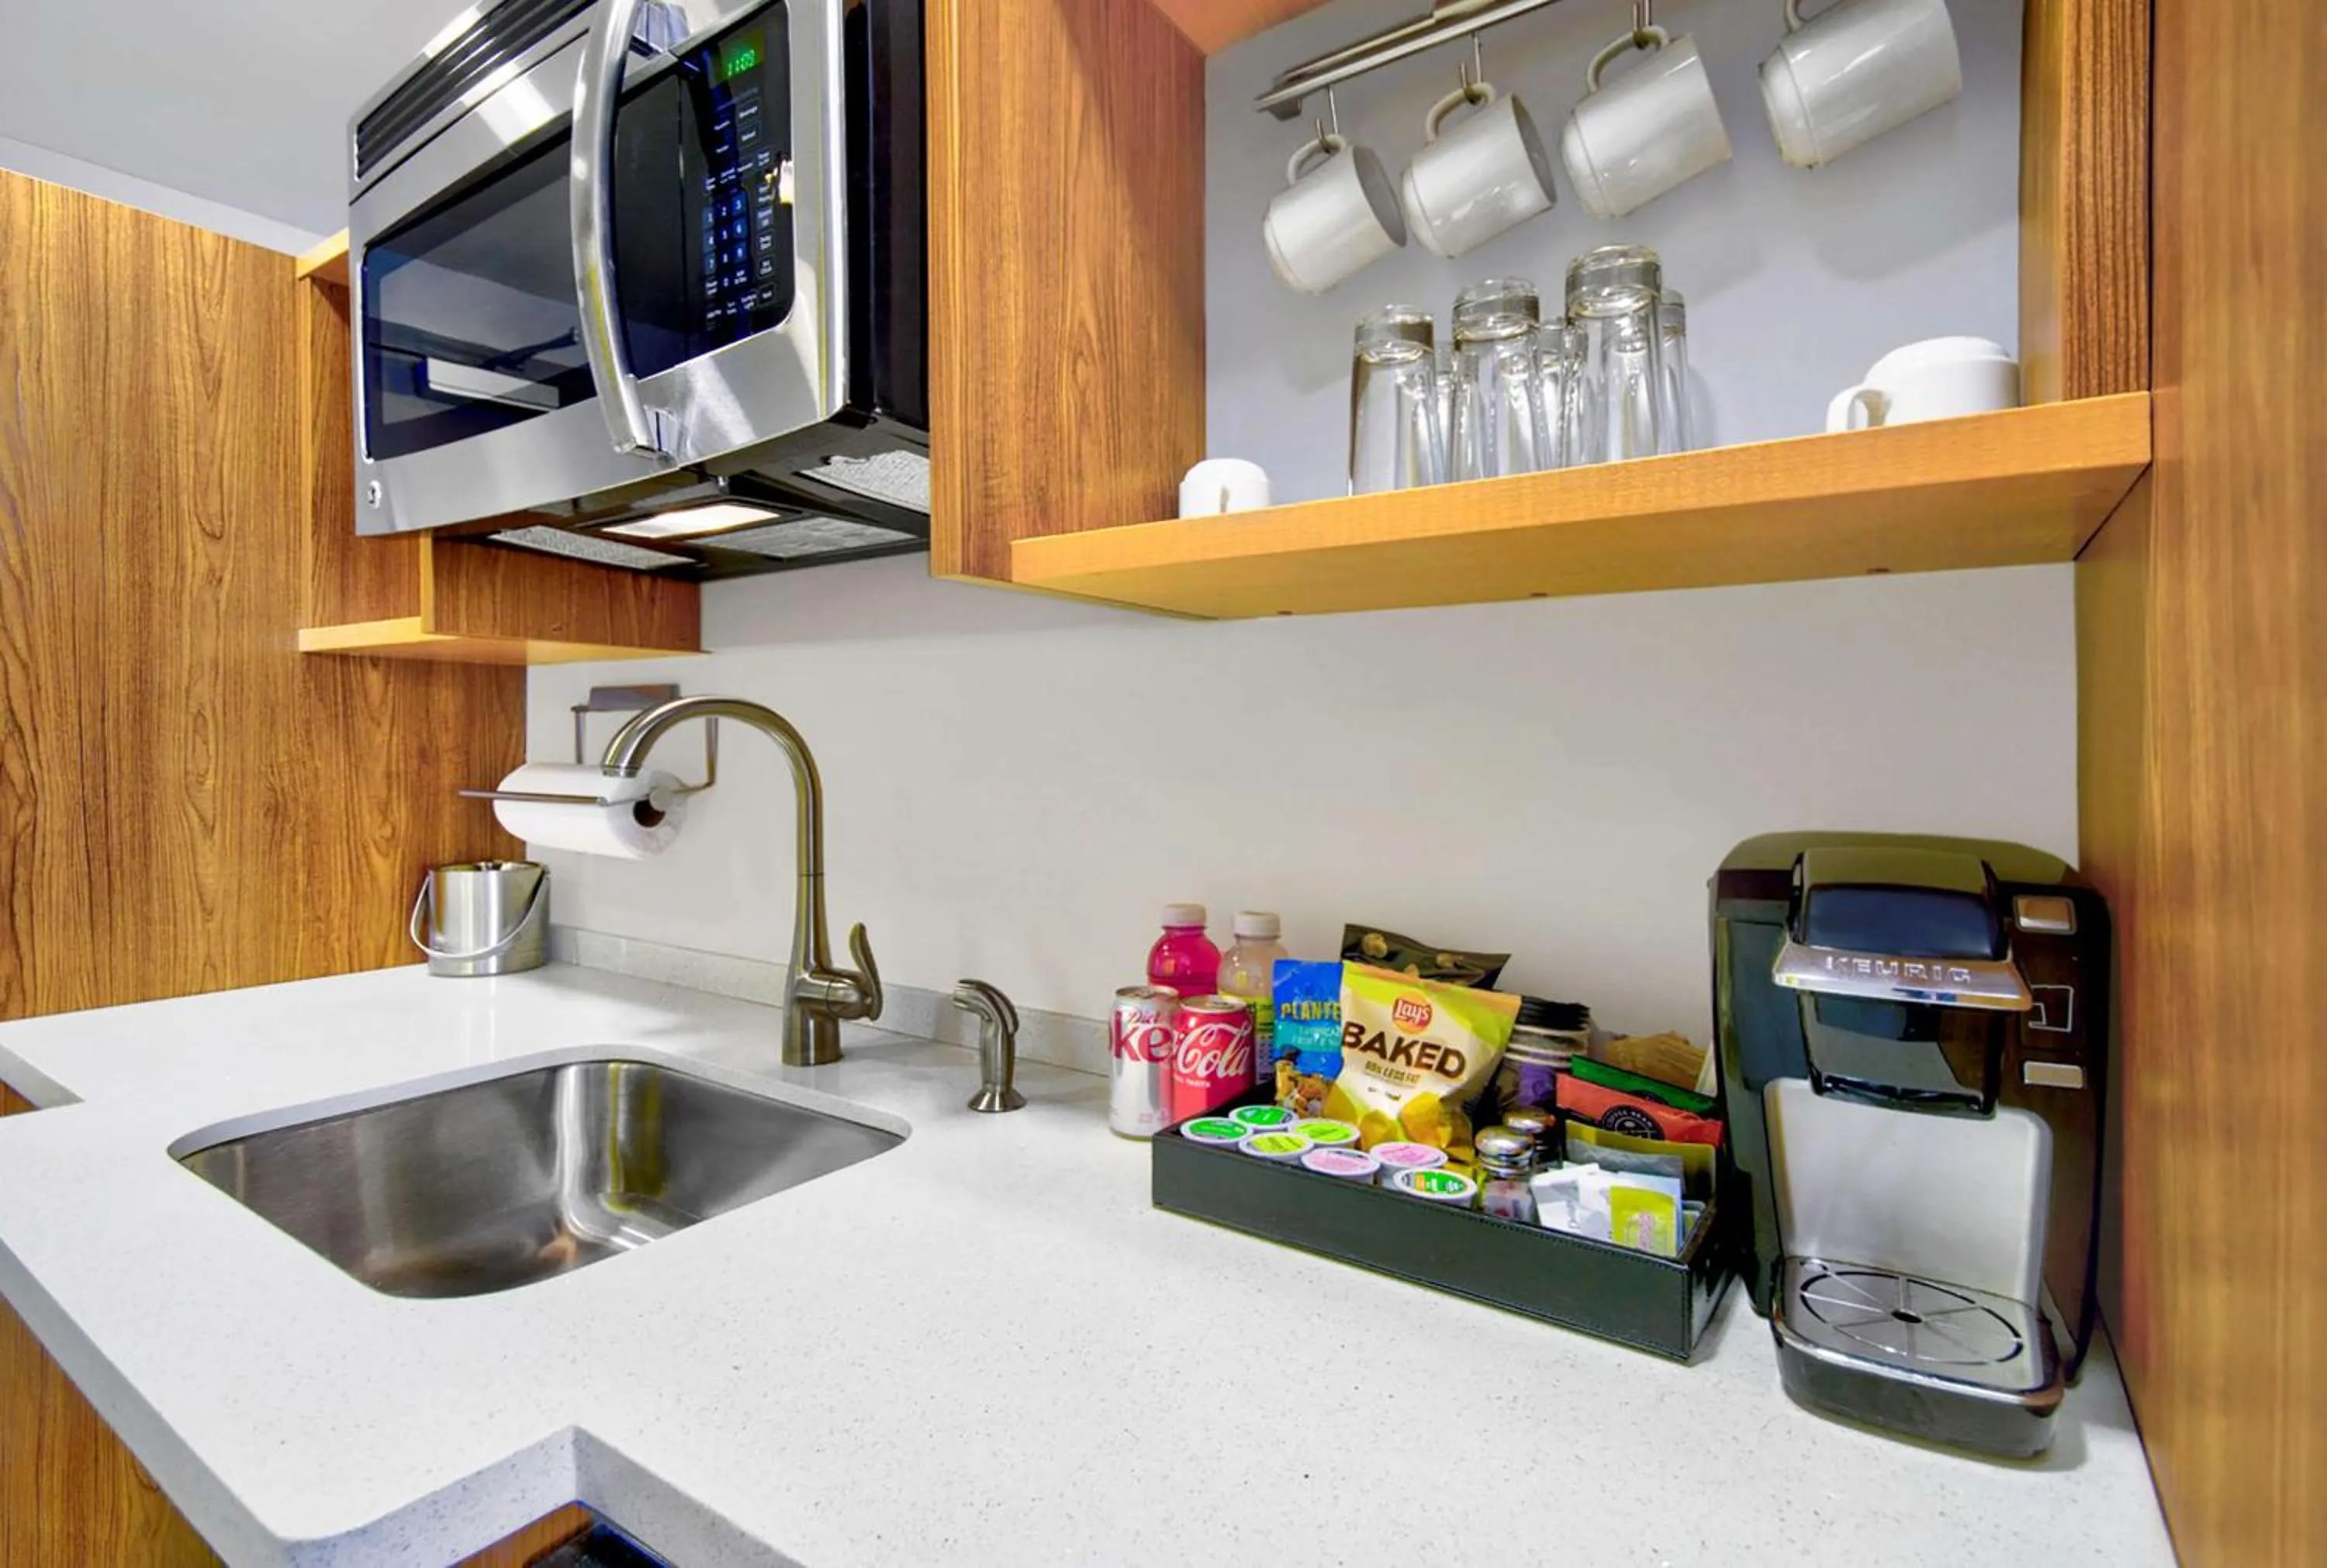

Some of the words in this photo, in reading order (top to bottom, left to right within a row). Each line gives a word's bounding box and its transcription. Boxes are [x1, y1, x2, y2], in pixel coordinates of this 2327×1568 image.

[1825, 956, 1970, 984] KEURIG
[1281, 1000, 1340, 1021] PLANTE
[1395, 999, 1429, 1024] Lay's
[1109, 1010, 1173, 1062] ke
[1177, 1021, 1253, 1079] Cola
[1341, 1021, 1466, 1079] BAKED
